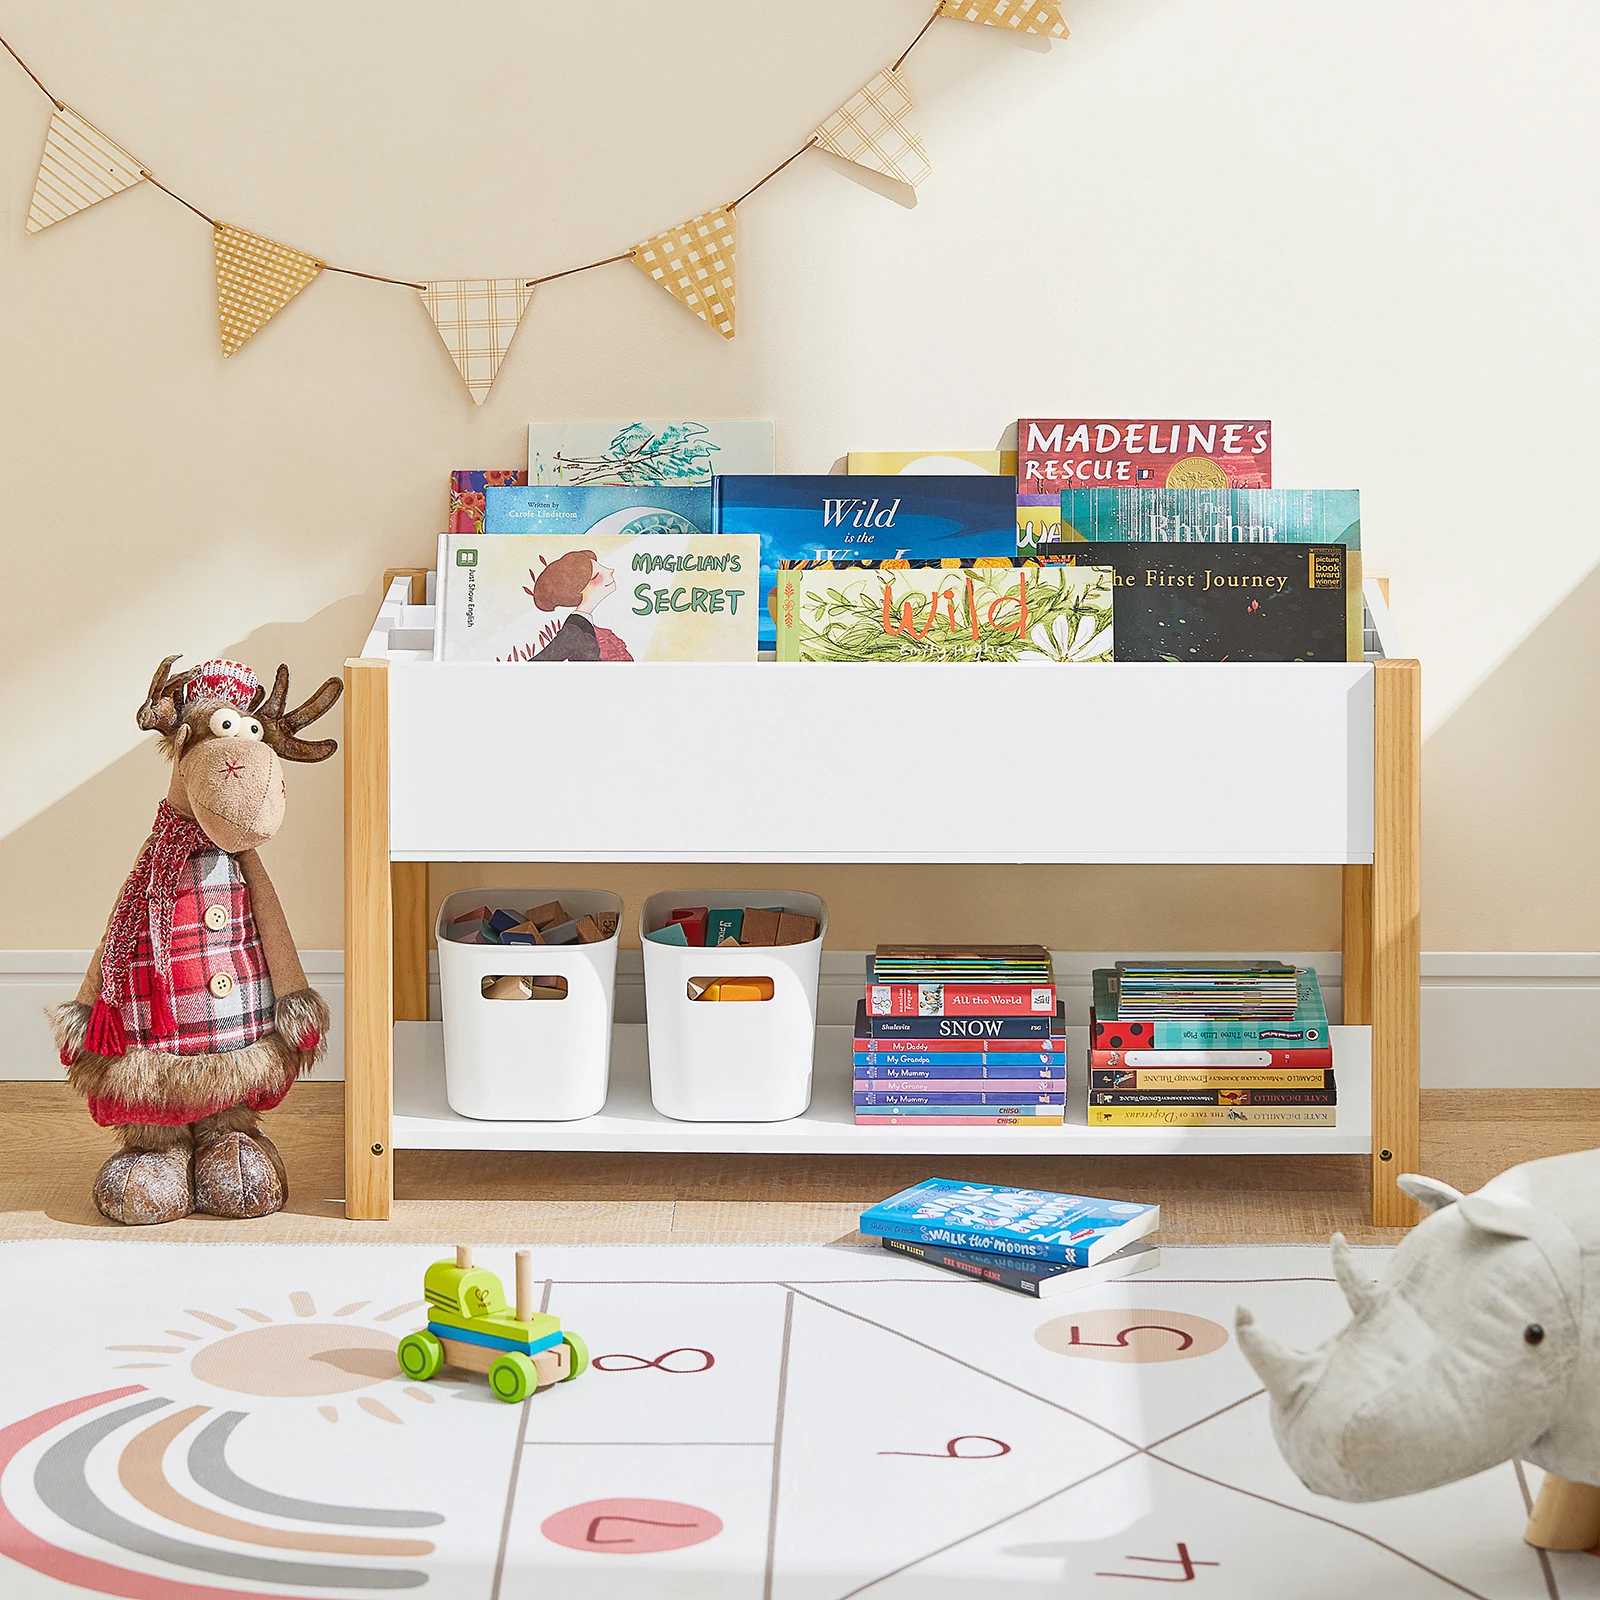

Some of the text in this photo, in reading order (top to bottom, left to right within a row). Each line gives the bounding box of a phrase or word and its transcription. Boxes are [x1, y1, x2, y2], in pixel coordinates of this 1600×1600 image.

[1025, 459, 1132, 481] RESCUE
[508, 509, 578, 518] Carole Lindstrom
[822, 498, 902, 528] Wild
[844, 531, 875, 543] is the
[631, 552, 742, 575] MAGICIAN'S
[1315, 564, 1340, 572] book
[1112, 569, 1288, 593] he First Journey
[466, 568, 476, 628] Just Show English
[631, 583, 746, 616] SECRET
[899, 641, 1014, 661] Emily Hughes
[952, 995, 971, 1005] All
[972, 995, 989, 1005] the
[990, 995, 1022, 1005] World
[940, 1020, 1004, 1037] SNOW
[1182, 1031, 1257, 1040] The Three Little Pigs
[892, 1042, 929, 1051] My Daddy
[886, 1054, 930, 1065] My Grandpa
[887, 1069, 930, 1079] My Mummy
[1143, 1075, 1174, 1083] TULANE
[1174, 1075, 1208, 1083] EDWARD
[888, 1081, 928, 1090] My Granny
[886, 1095, 929, 1104] My Mummy
[1303, 1094, 1328, 1102] KATE
[1125, 1109, 1178, 1123] Despereaux
[911, 1185, 994, 1219] WALK
[890, 1240, 925, 1257] ELLEN RASKIN
[928, 1228, 967, 1245] WALK
[968, 1233, 991, 1249] two
[993, 1238, 1037, 1256] moons
[943, 1257, 955, 1267] THE
[983, 1269, 1001, 1281] GAME
[1068, 1325, 1194, 1351] 5
[1095, 1542, 1220, 1583] 4
